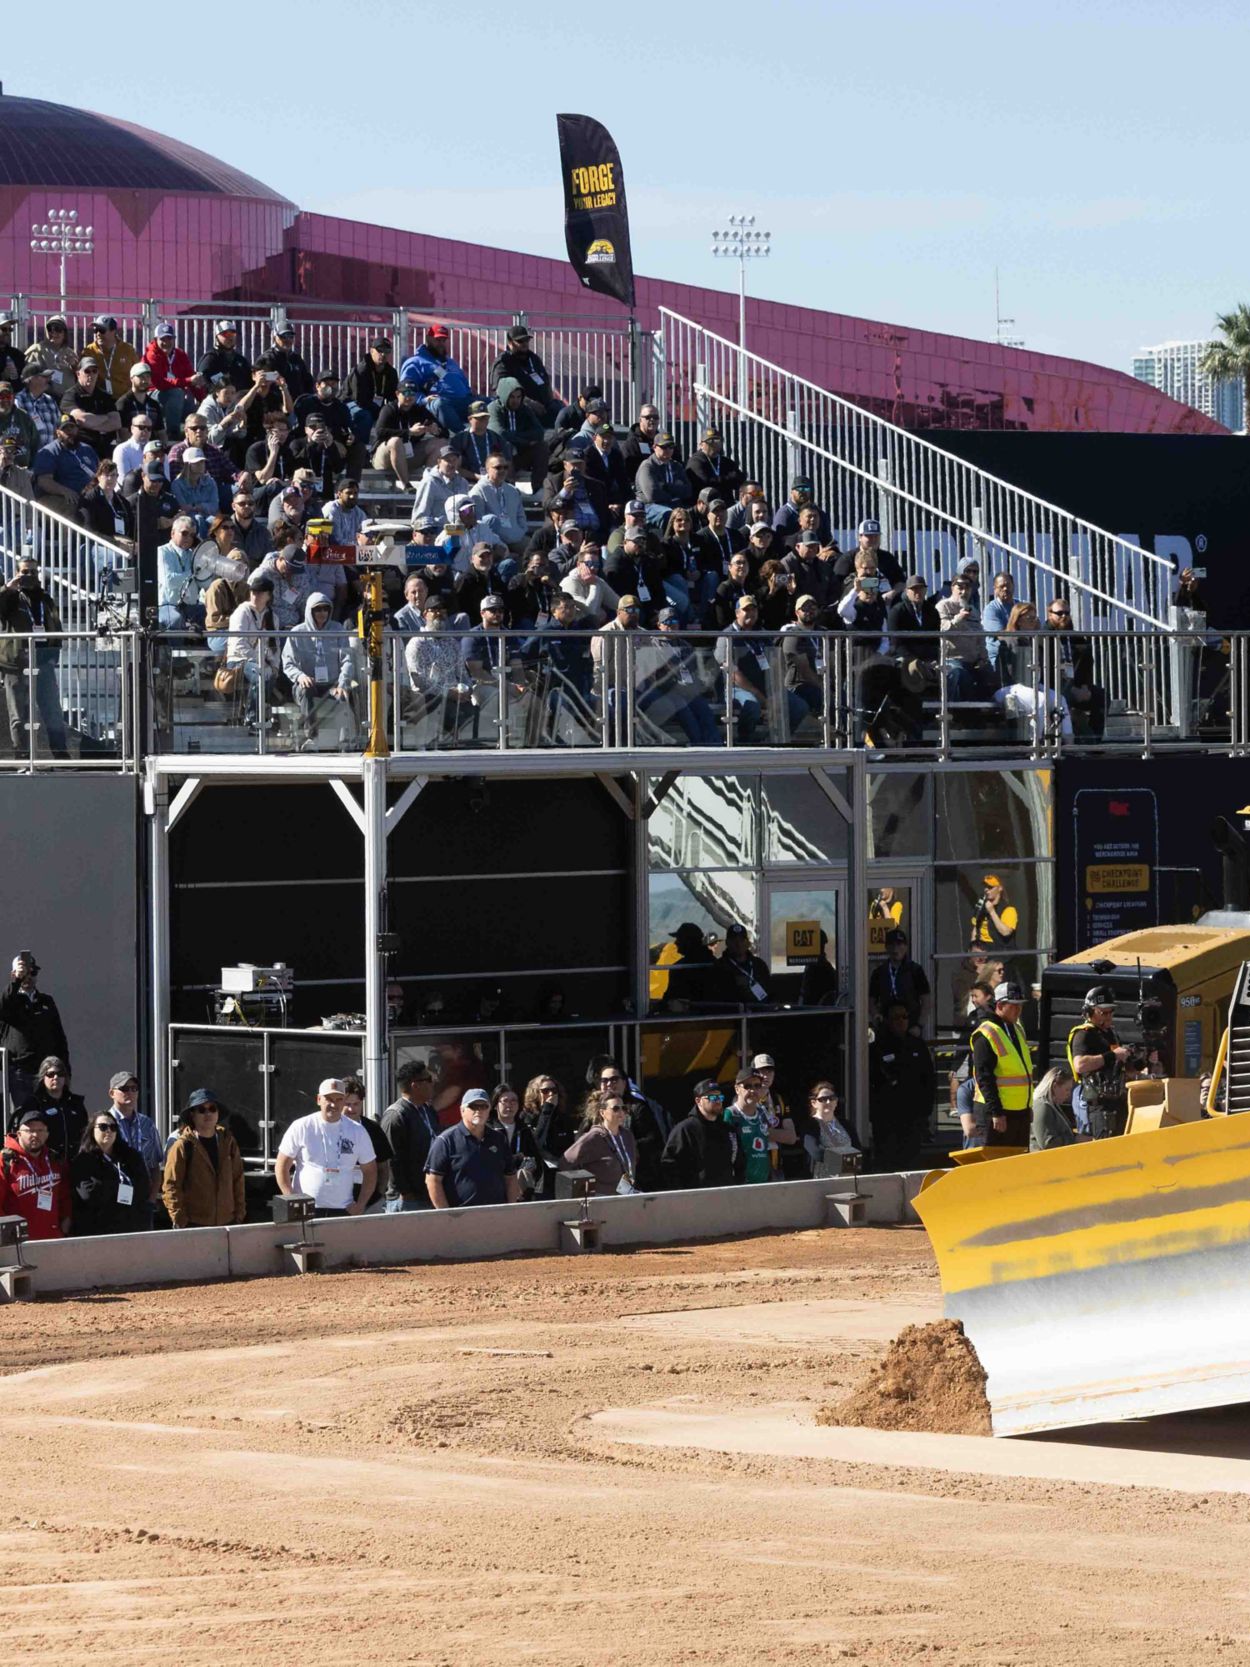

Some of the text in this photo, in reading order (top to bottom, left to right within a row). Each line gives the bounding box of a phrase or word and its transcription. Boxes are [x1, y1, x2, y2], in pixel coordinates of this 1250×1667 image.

[572, 163, 615, 195] FORGE
[574, 193, 616, 210] YOUR LEGACY
[1102, 869, 1142, 878] CHECKPOINT
[1103, 880, 1139, 888] CHALLENGE
[793, 930, 815, 947] CAT
